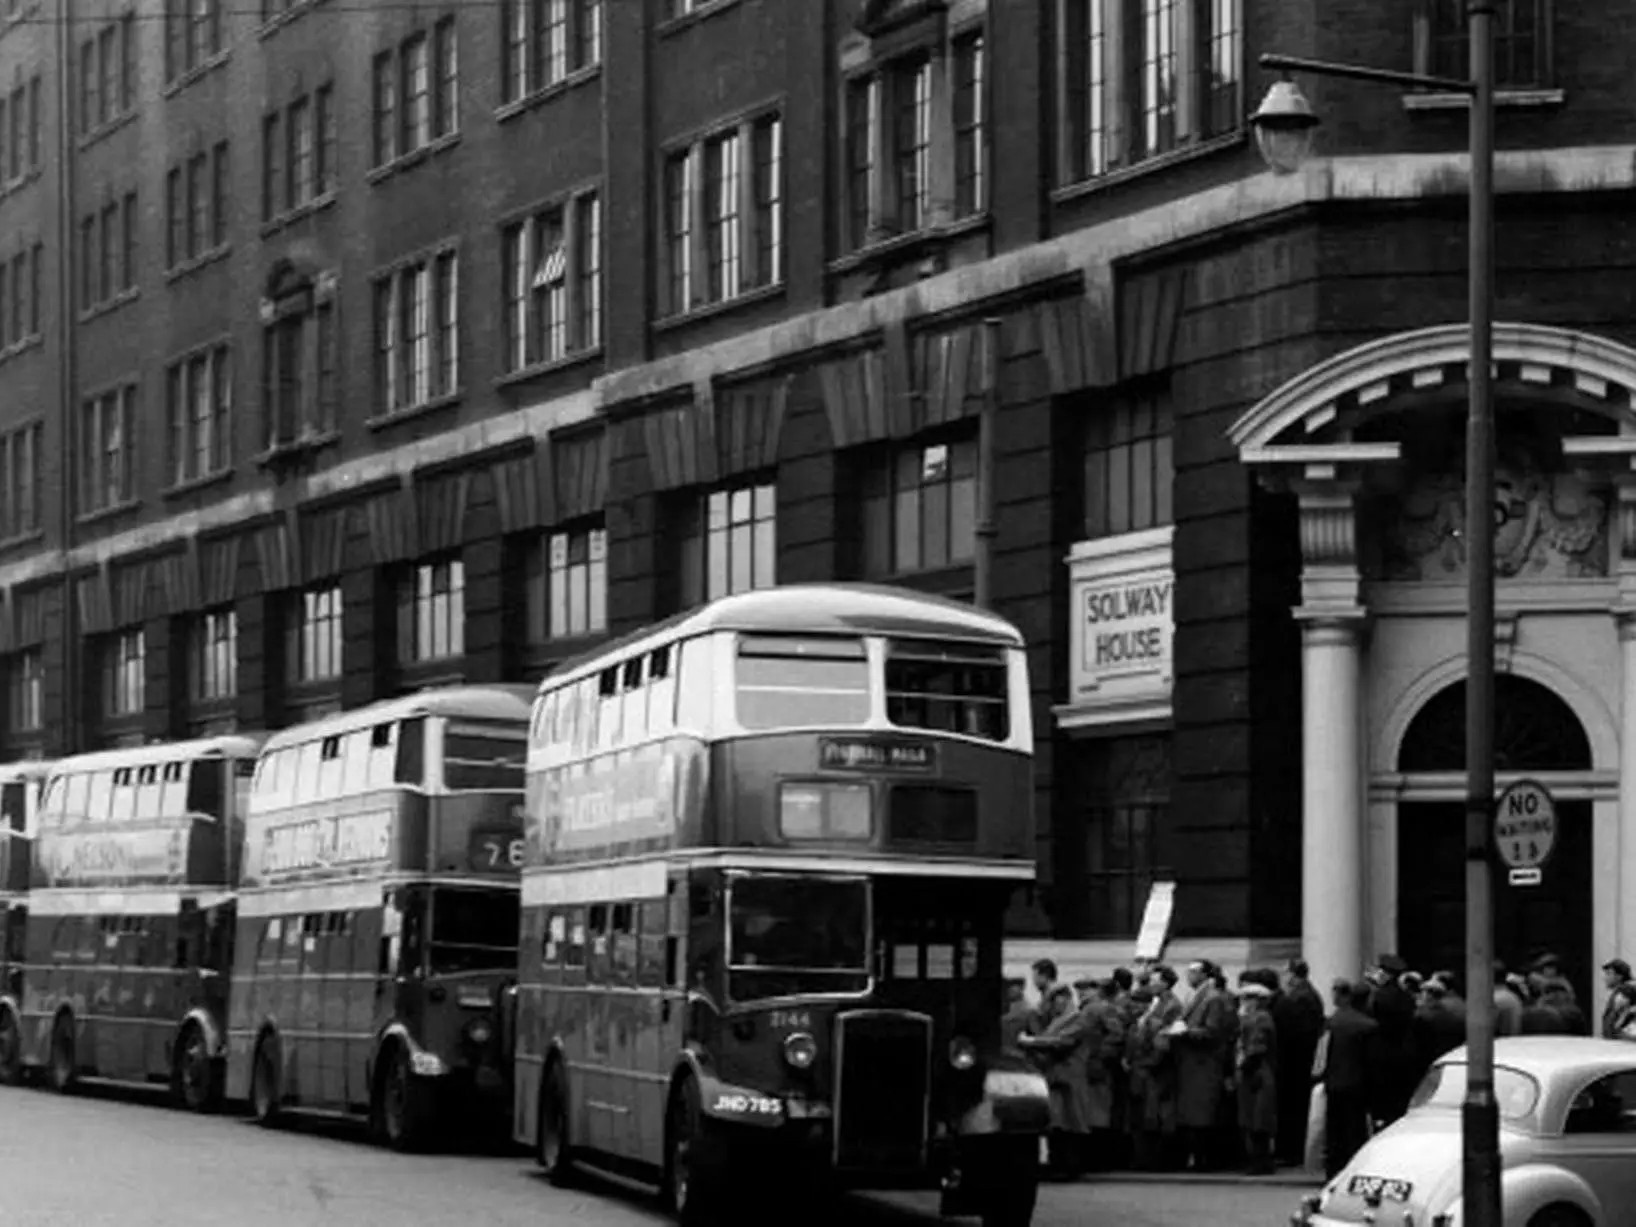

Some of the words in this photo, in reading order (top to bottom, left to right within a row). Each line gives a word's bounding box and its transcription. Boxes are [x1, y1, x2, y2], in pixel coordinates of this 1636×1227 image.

[1088, 584, 1169, 623] SOLWAY
[1096, 628, 1160, 664] HOUSE
[1509, 794, 1537, 816] NO
